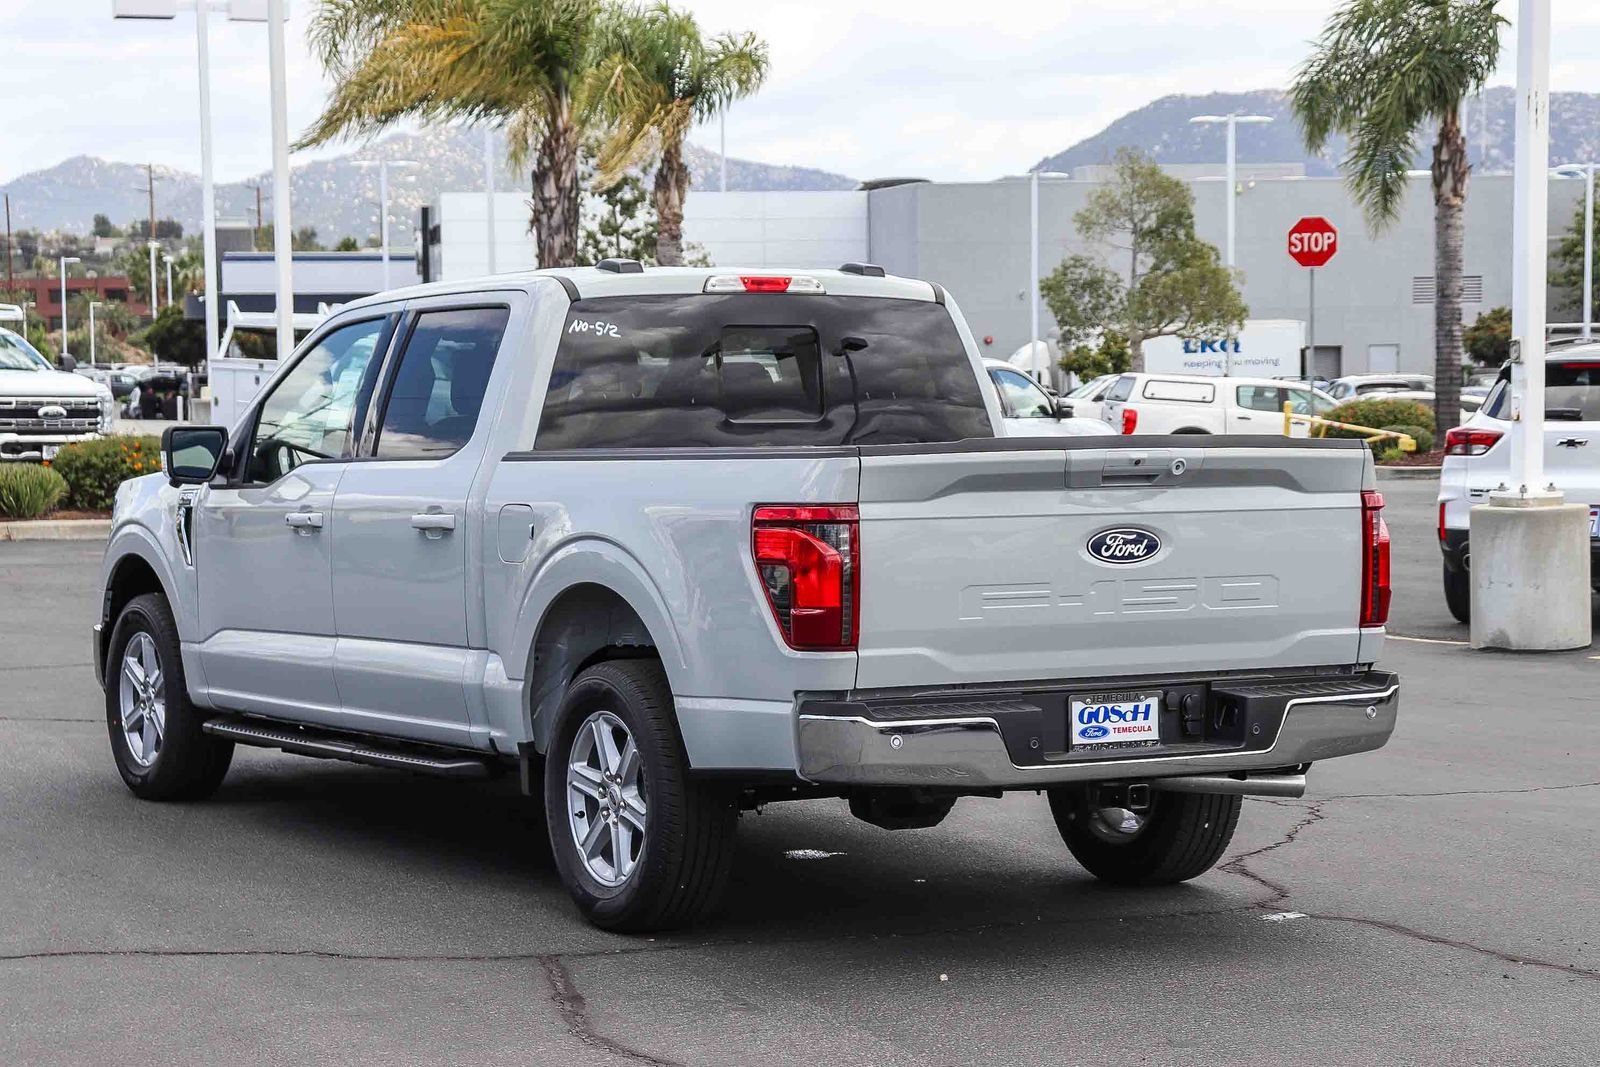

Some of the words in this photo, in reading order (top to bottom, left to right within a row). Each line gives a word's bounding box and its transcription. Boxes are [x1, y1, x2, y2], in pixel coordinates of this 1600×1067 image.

[1290, 232, 1335, 252] STOP
[1101, 533, 1148, 557] Ford
[959, 574, 1280, 620] F-150
[1092, 692, 1140, 702] TEMECULA
[1085, 728, 1103, 738] Ford
[1113, 725, 1152, 734] TEMECULA
